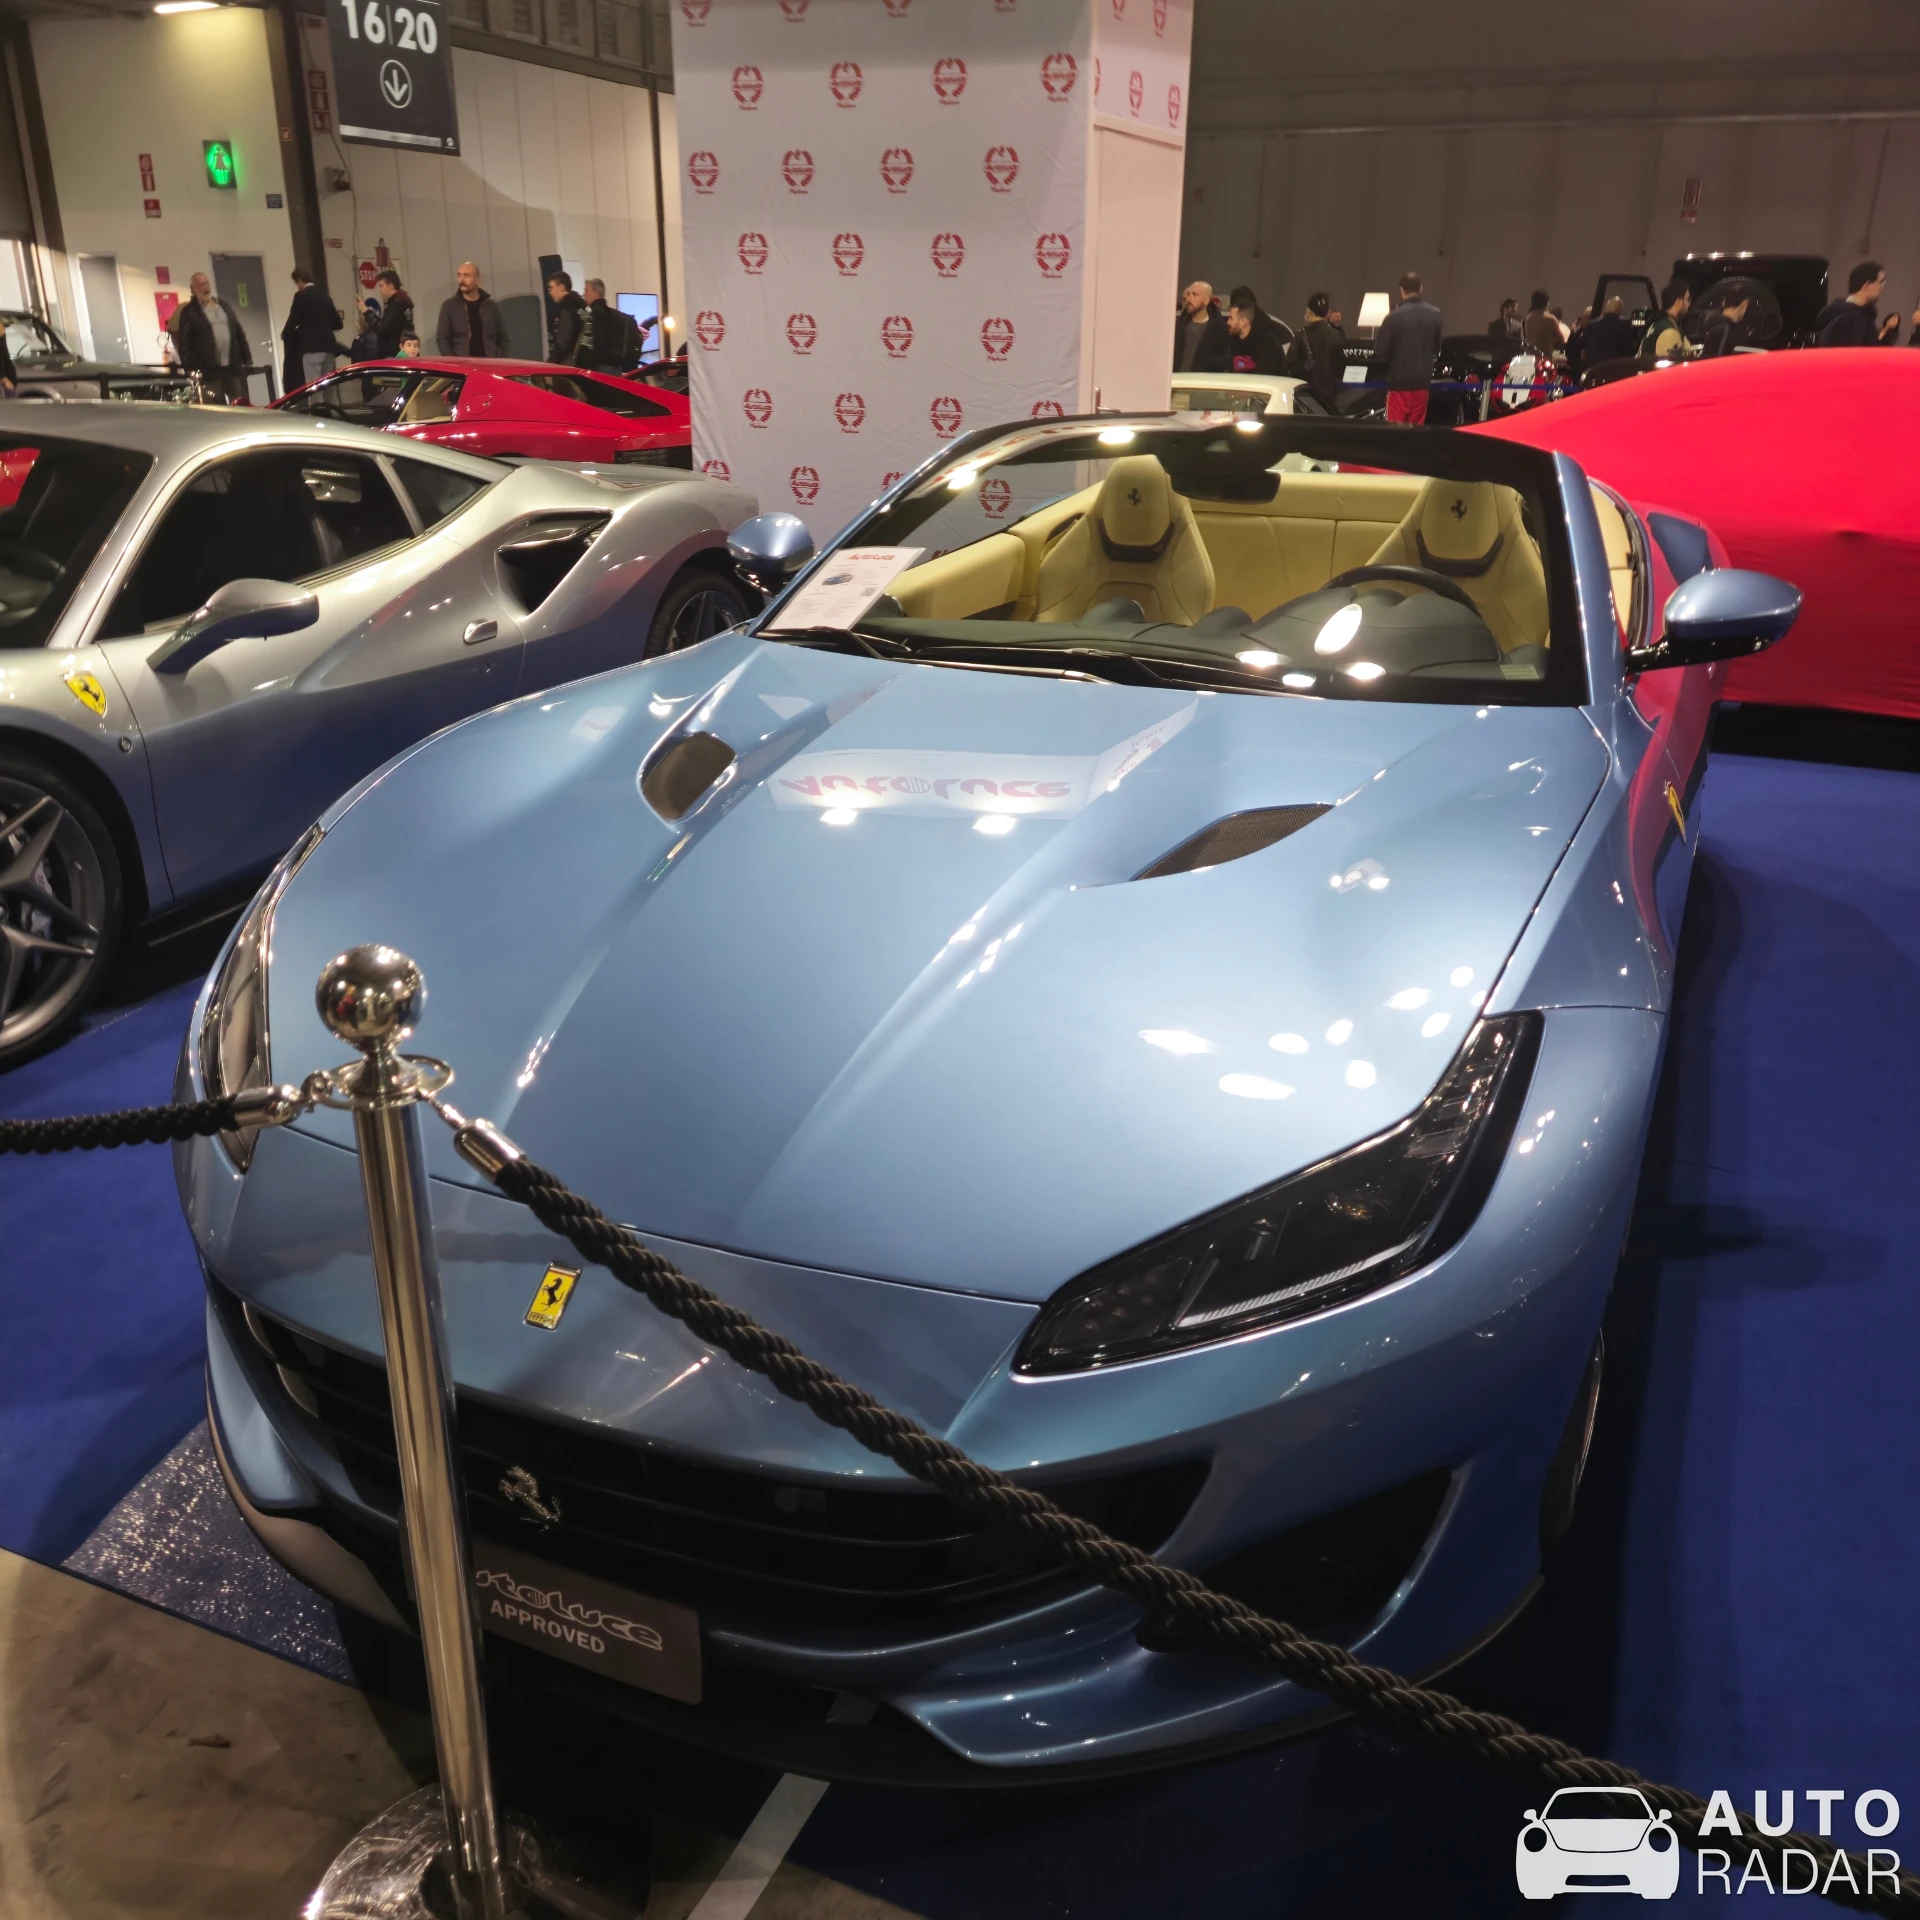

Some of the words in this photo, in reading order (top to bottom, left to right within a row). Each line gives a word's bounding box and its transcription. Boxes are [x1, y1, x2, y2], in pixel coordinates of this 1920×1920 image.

[341, 0, 386, 44] 16
[394, 8, 438, 54] 20
[529, 1312, 554, 1325] Ferrari
[490, 1599, 605, 1654] APPROVED
